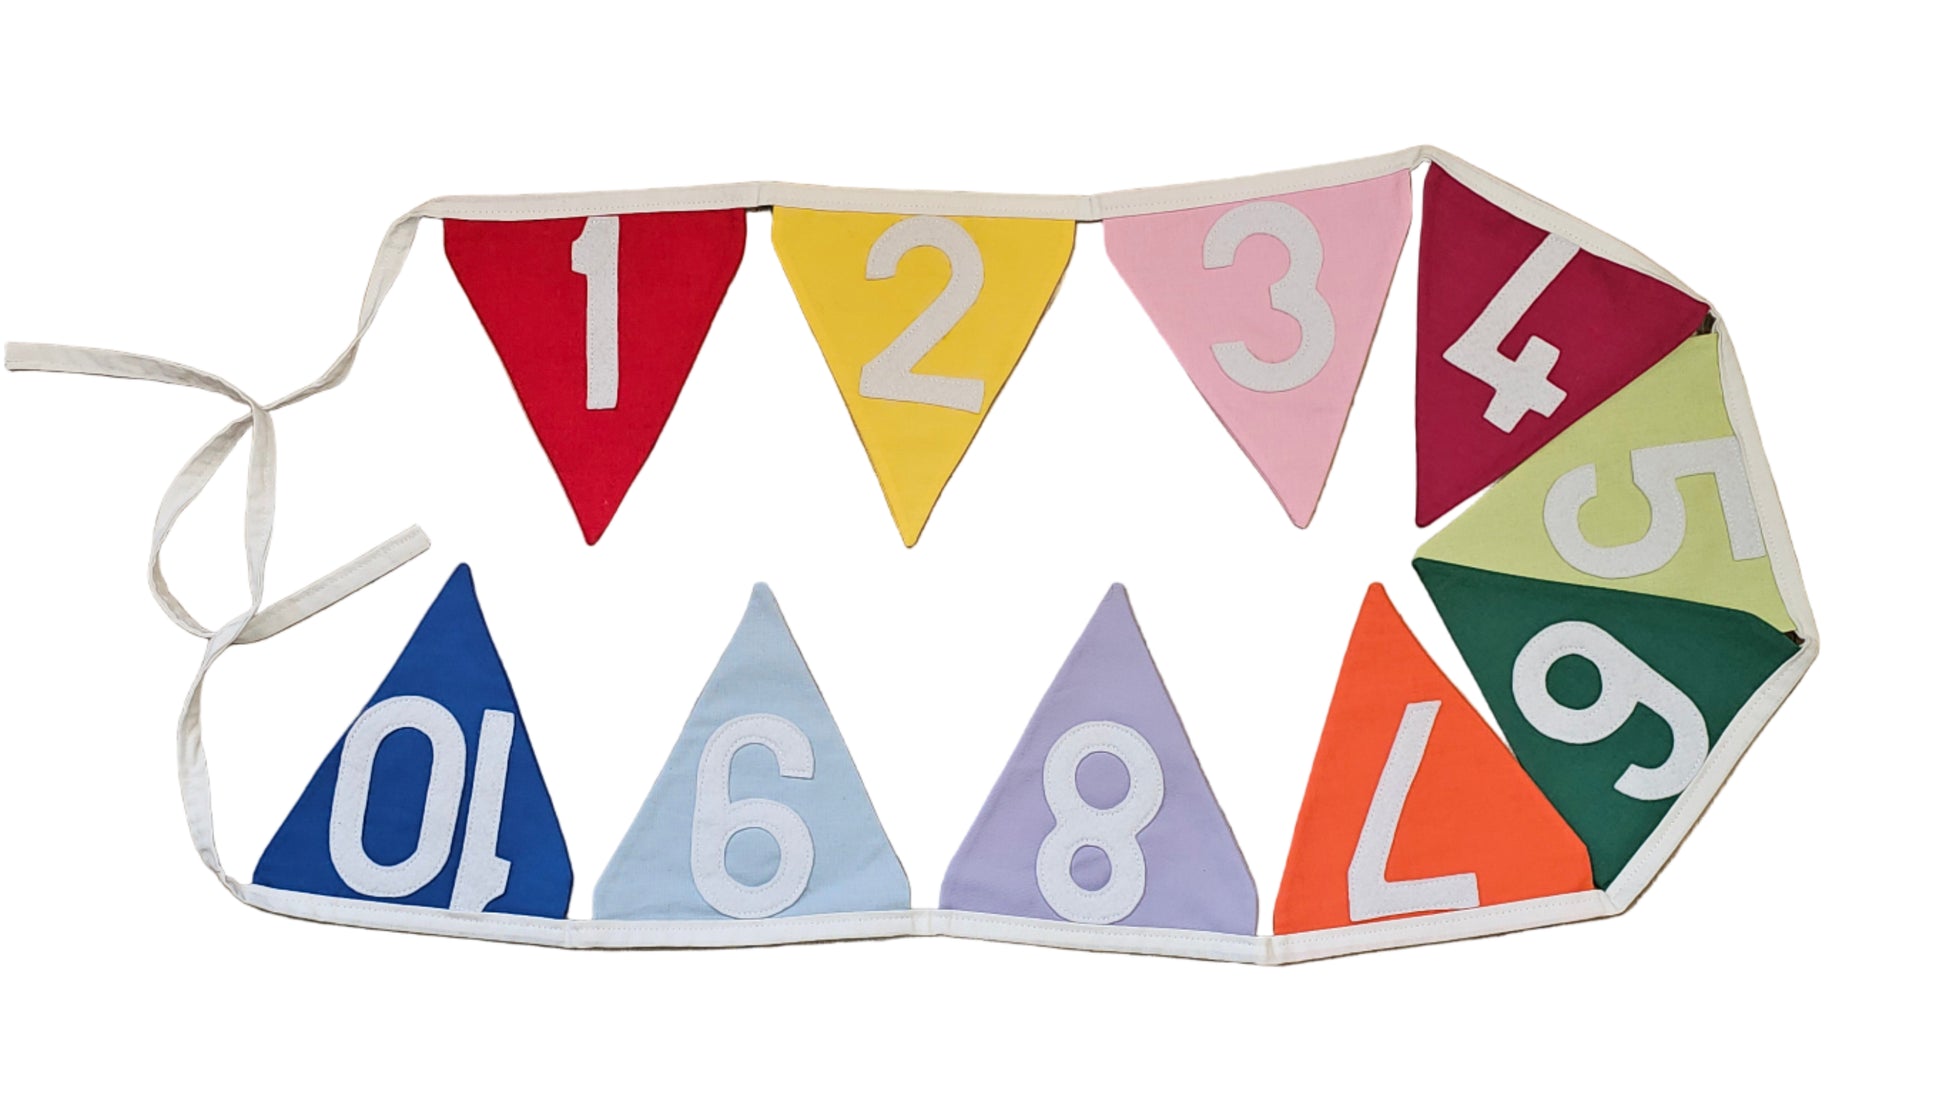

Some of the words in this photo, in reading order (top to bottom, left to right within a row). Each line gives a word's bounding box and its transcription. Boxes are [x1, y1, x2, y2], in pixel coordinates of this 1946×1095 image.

[571, 216, 619, 410] 1
[859, 215, 985, 414] 2
[1203, 202, 1334, 393] 3
[1442, 232, 1567, 433] 4
[1543, 435, 1766, 579] 5
[329, 695, 515, 912] 10
[1512, 620, 1709, 800] 6
[691, 713, 815, 919] 9
[1036, 721, 1165, 923] 8
[1348, 700, 1480, 922] 7
